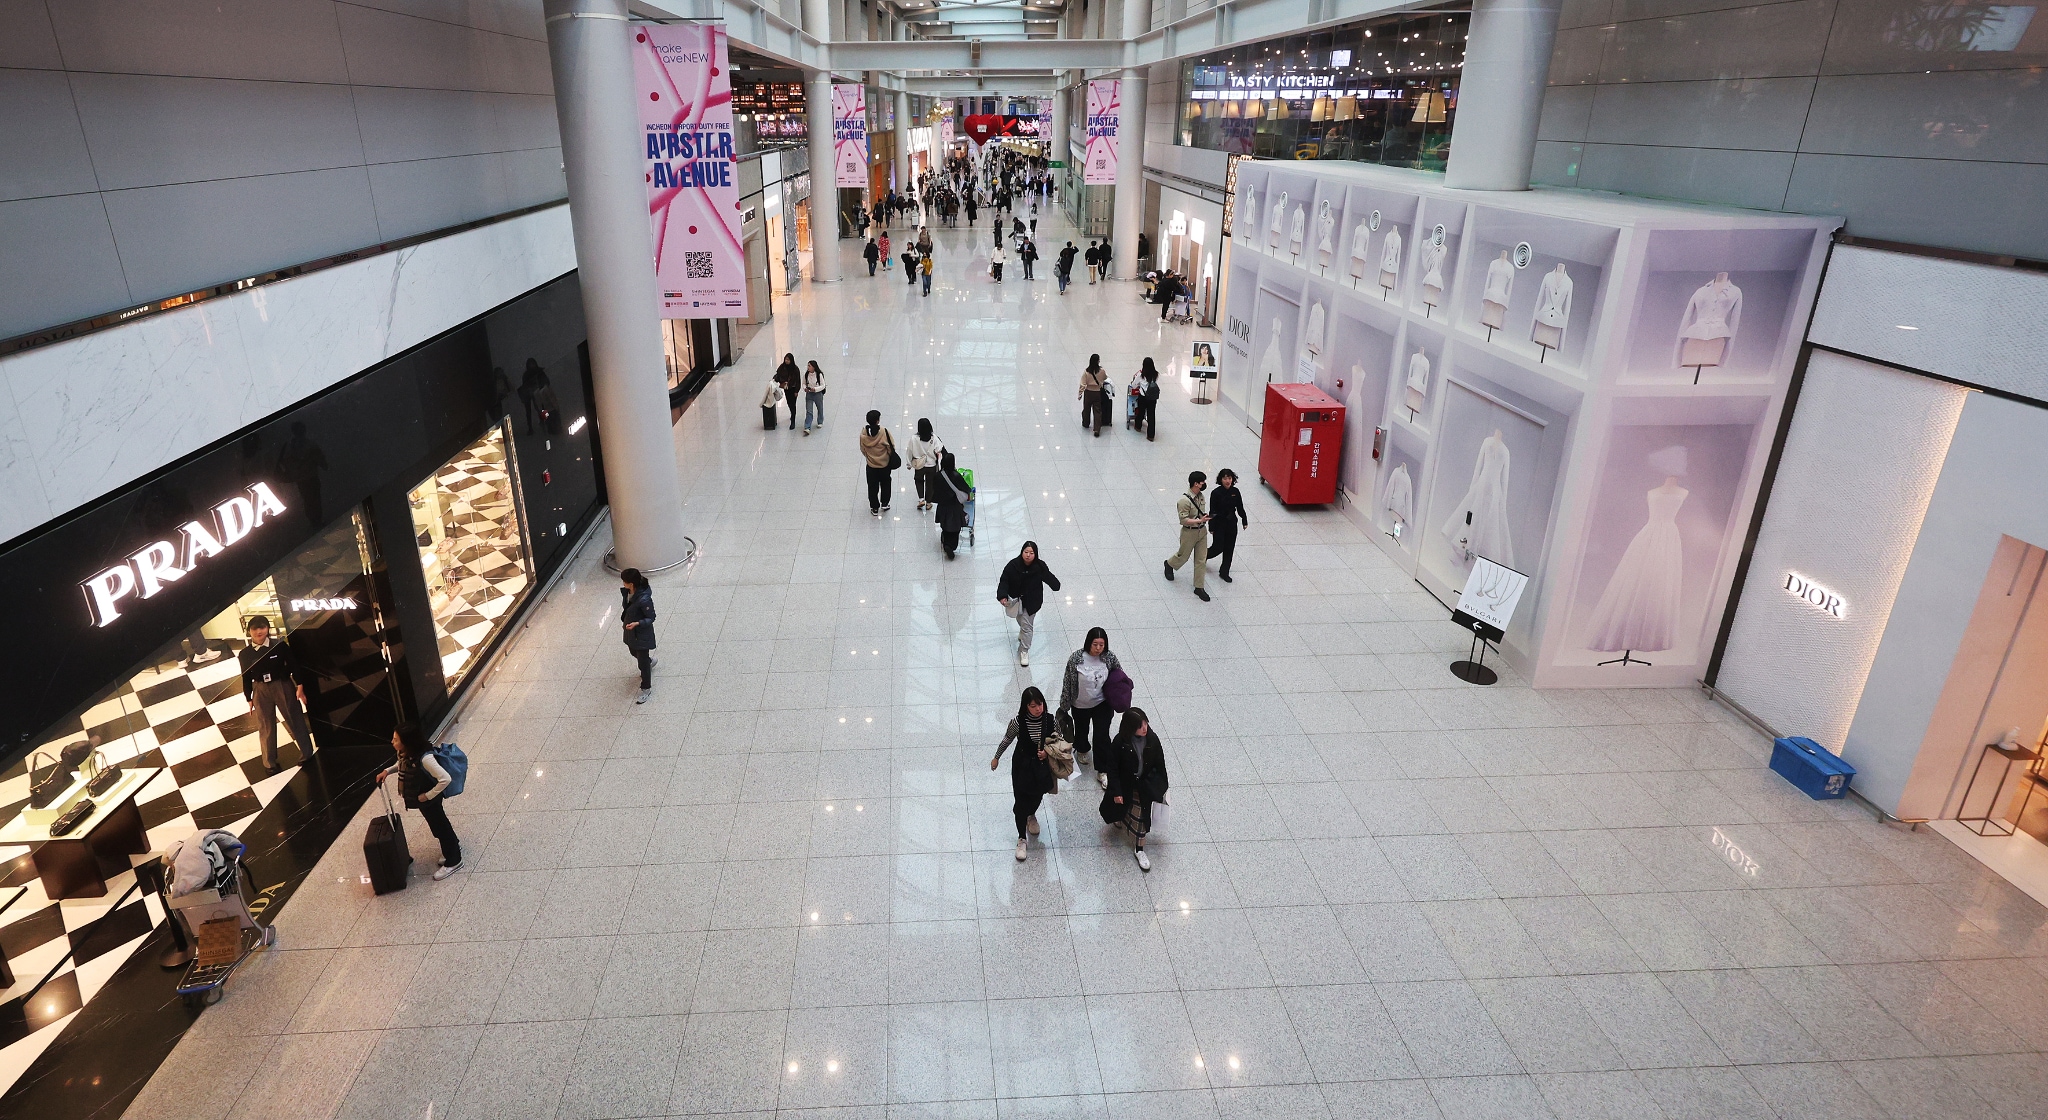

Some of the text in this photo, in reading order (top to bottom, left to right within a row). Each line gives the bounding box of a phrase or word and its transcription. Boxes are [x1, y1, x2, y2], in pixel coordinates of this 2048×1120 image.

[651, 44, 682, 54] make
[1231, 75, 1334, 88] TASTY KITCHEN
[835, 120, 865, 130] AIRSTAR
[1088, 117, 1118, 127] AIRSTAR
[836, 130, 864, 140] AVENUE
[1089, 127, 1116, 137] AVENUE
[646, 132, 733, 159] AIRSTAR
[654, 161, 732, 188] AVENUE
[1229, 315, 1250, 344] DIOR
[79, 480, 287, 628] PRADA
[1784, 573, 1842, 618] DIOR
[291, 597, 358, 612] PRADA
[1464, 603, 1502, 624] BVLGARI
